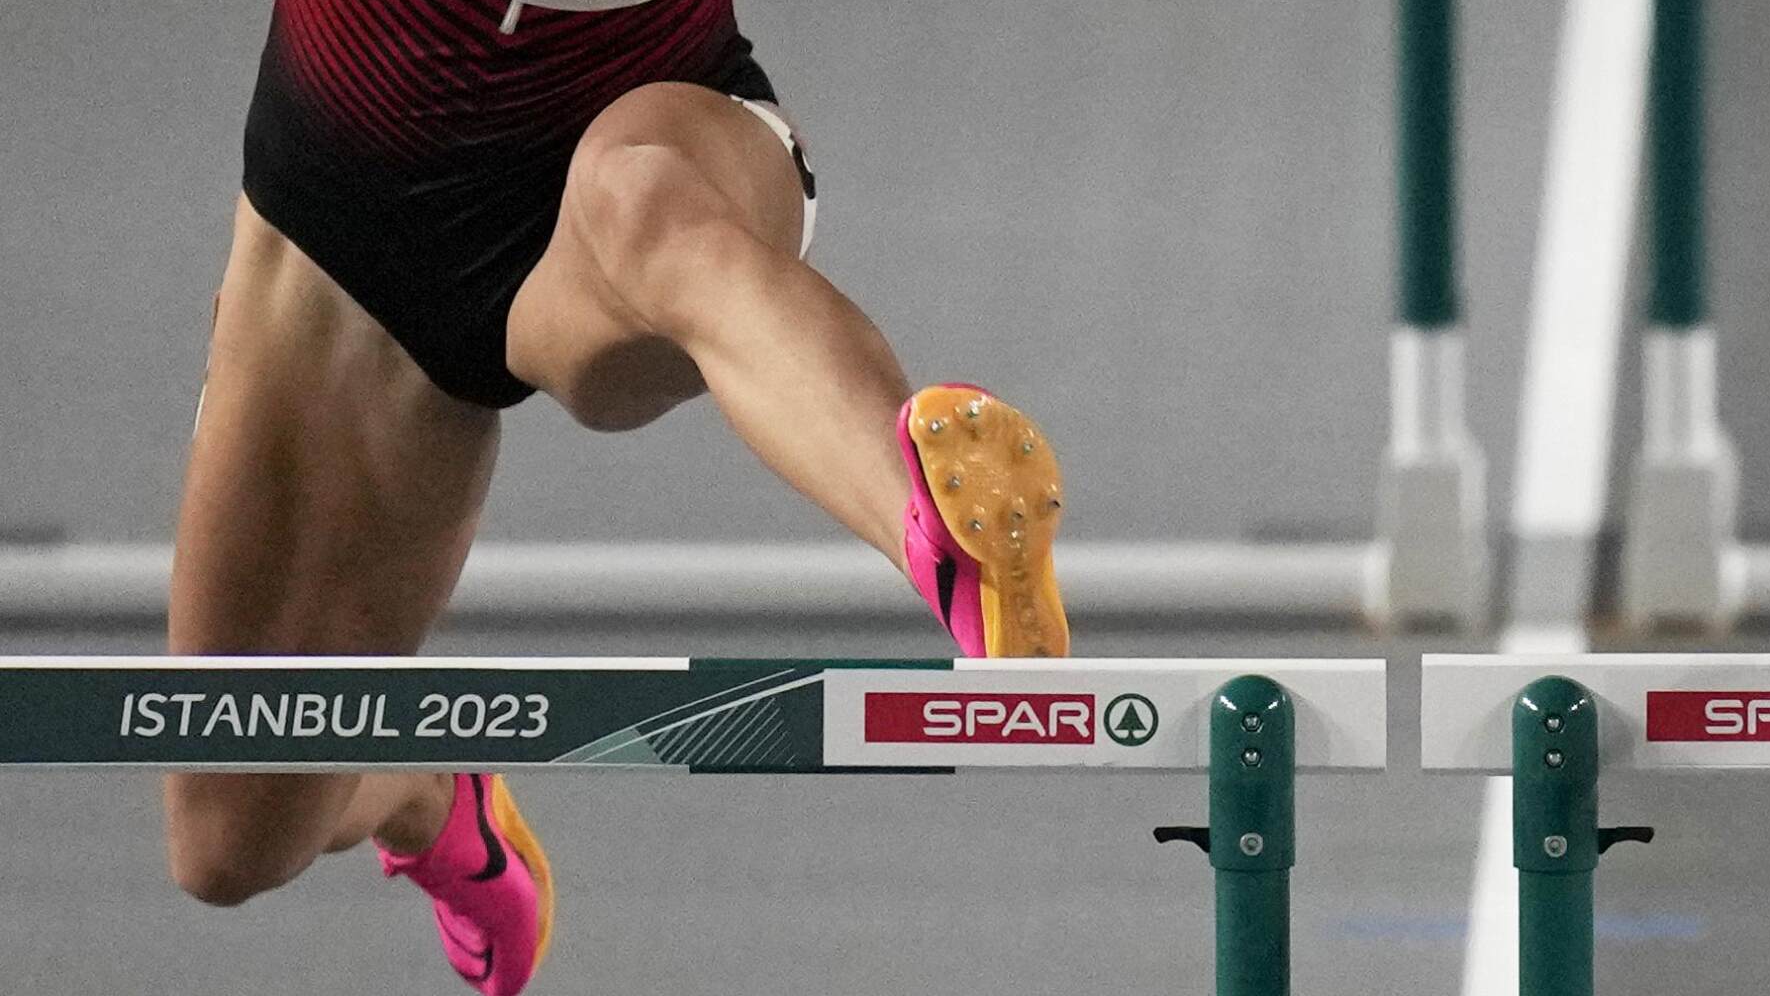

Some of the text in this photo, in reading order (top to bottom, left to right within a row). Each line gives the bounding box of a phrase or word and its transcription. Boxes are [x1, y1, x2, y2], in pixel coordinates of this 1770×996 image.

[119, 692, 549, 737] ISTANBUL 2023
[923, 700, 1090, 737] SPAR
